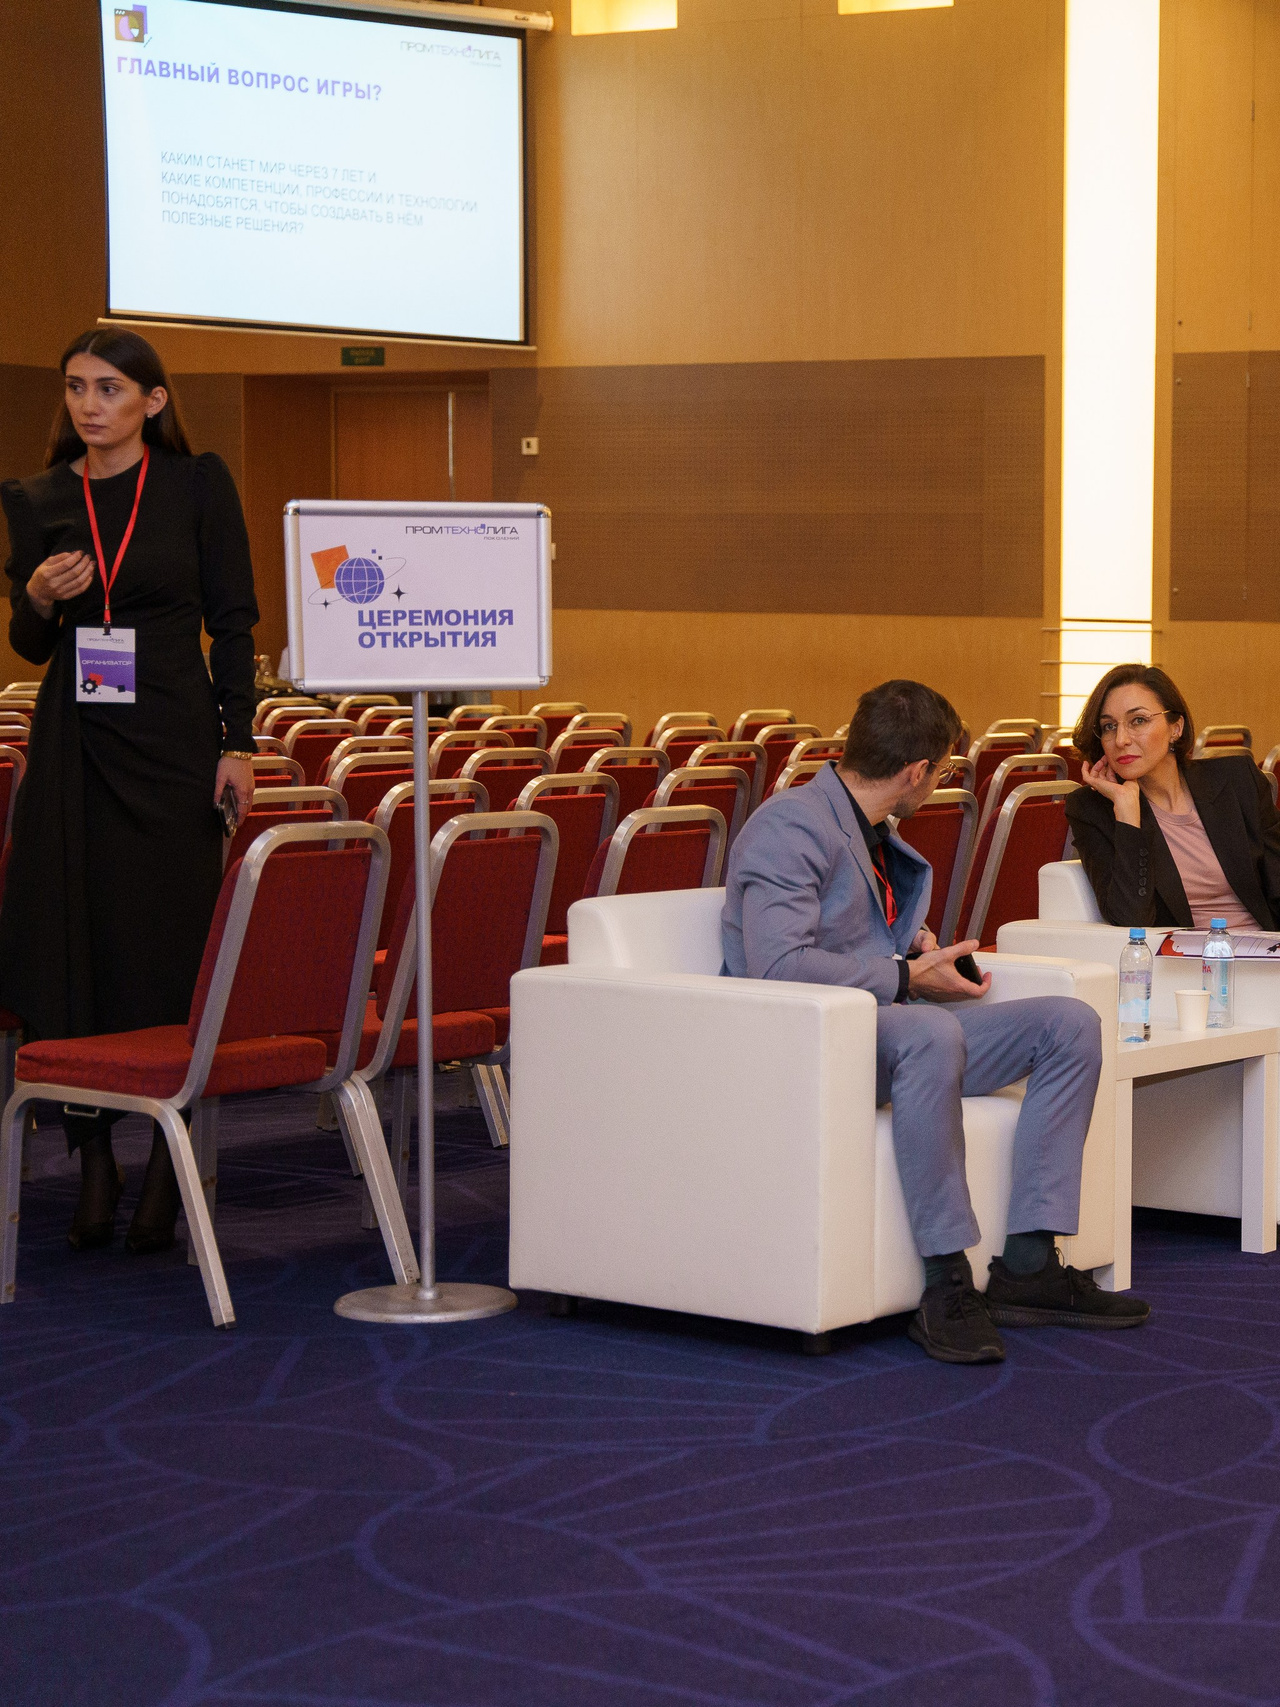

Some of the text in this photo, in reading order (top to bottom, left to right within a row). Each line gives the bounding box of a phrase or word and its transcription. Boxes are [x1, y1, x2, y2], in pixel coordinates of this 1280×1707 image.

[117, 56, 382, 101] ГЛАВНЫЙ ВОПРОС ИГРЫ?
[161, 151, 377, 183] КАКИМ СТАНЕТ МИР ЧЕРЕЗ 7 ЛЕТ И
[161, 171, 478, 213] КАКИЕ КОМПЕТЕНЦИИ, ПРОФЕССИИ И ТЕХНОЛОГИИ
[161, 190, 262, 213] ПОНАДОБЯТСЯ,
[264, 200, 308, 216] ЧТОБЫ
[310, 204, 383, 223] СОЗДАВАТЬ
[386, 212, 394, 224] В
[162, 209, 305, 234] ПОЛЕЗНЫЕ РЕШЕНИЯ?
[405, 524, 519, 535] ПРОМТЕХНОЛИГА
[357, 609, 514, 630] ЦЕРЕМОНИЯ
[357, 631, 497, 649] ОТКРЫТИЯ
